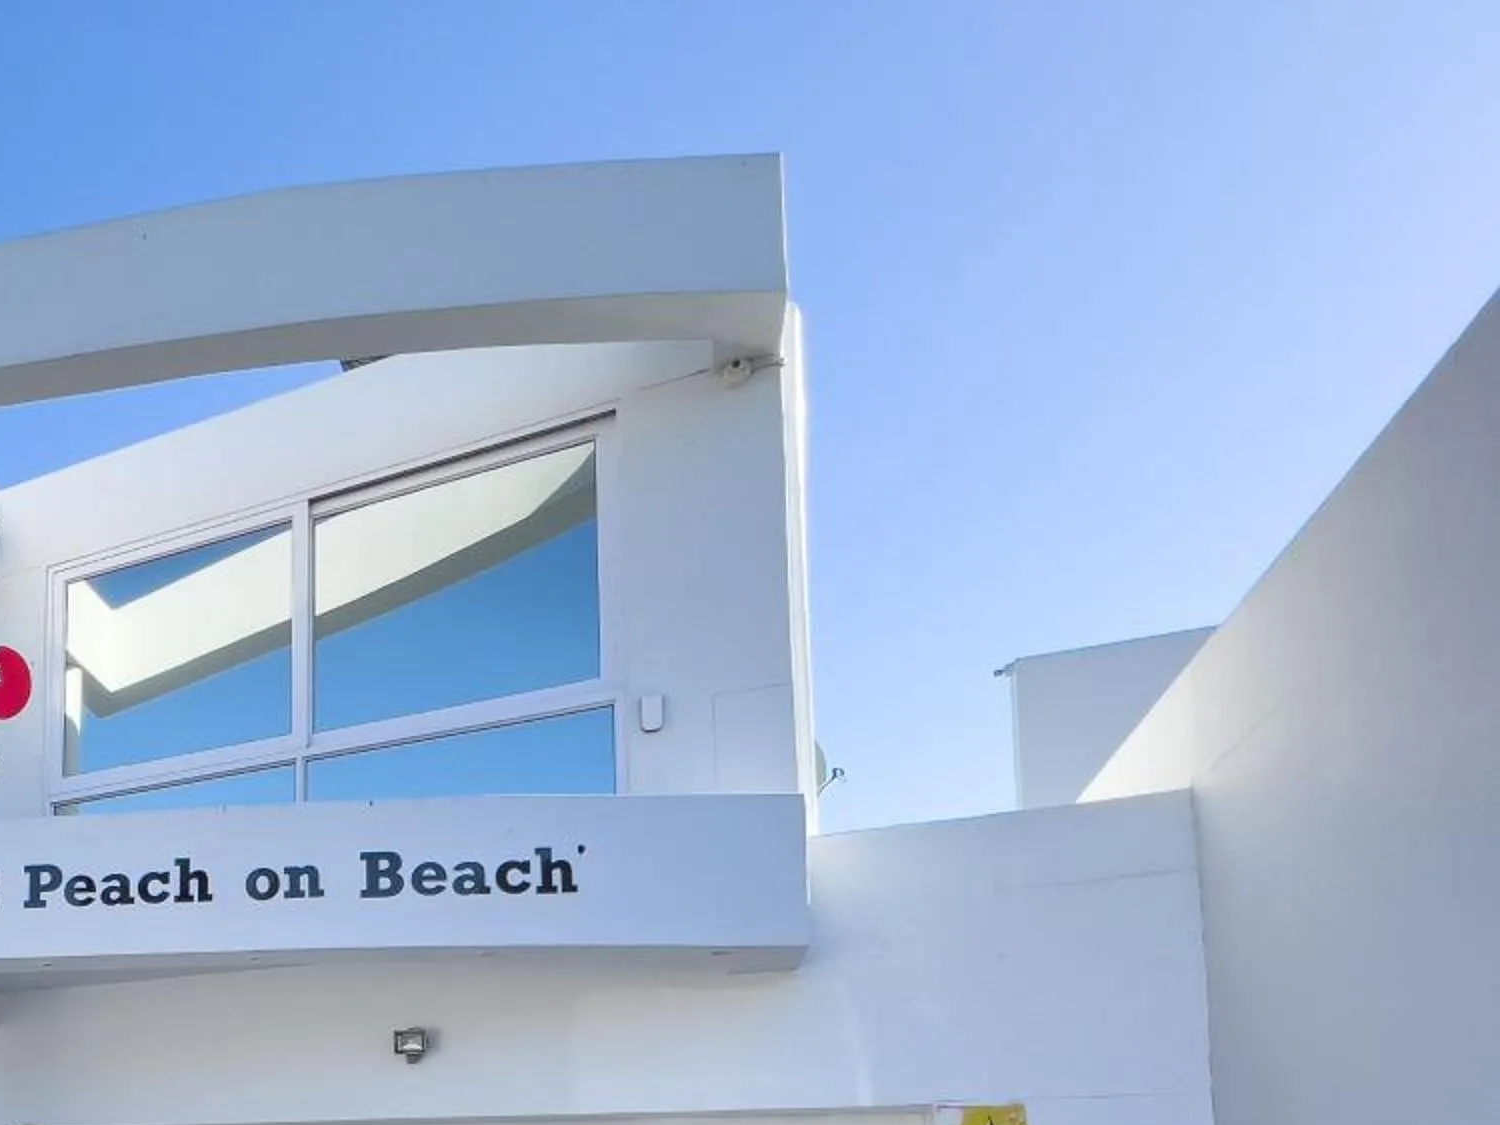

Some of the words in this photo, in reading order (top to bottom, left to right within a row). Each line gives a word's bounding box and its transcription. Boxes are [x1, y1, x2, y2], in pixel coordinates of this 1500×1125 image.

[23, 858, 213, 909] Peach
[245, 863, 325, 900] on
[359, 847, 579, 899] Beach
